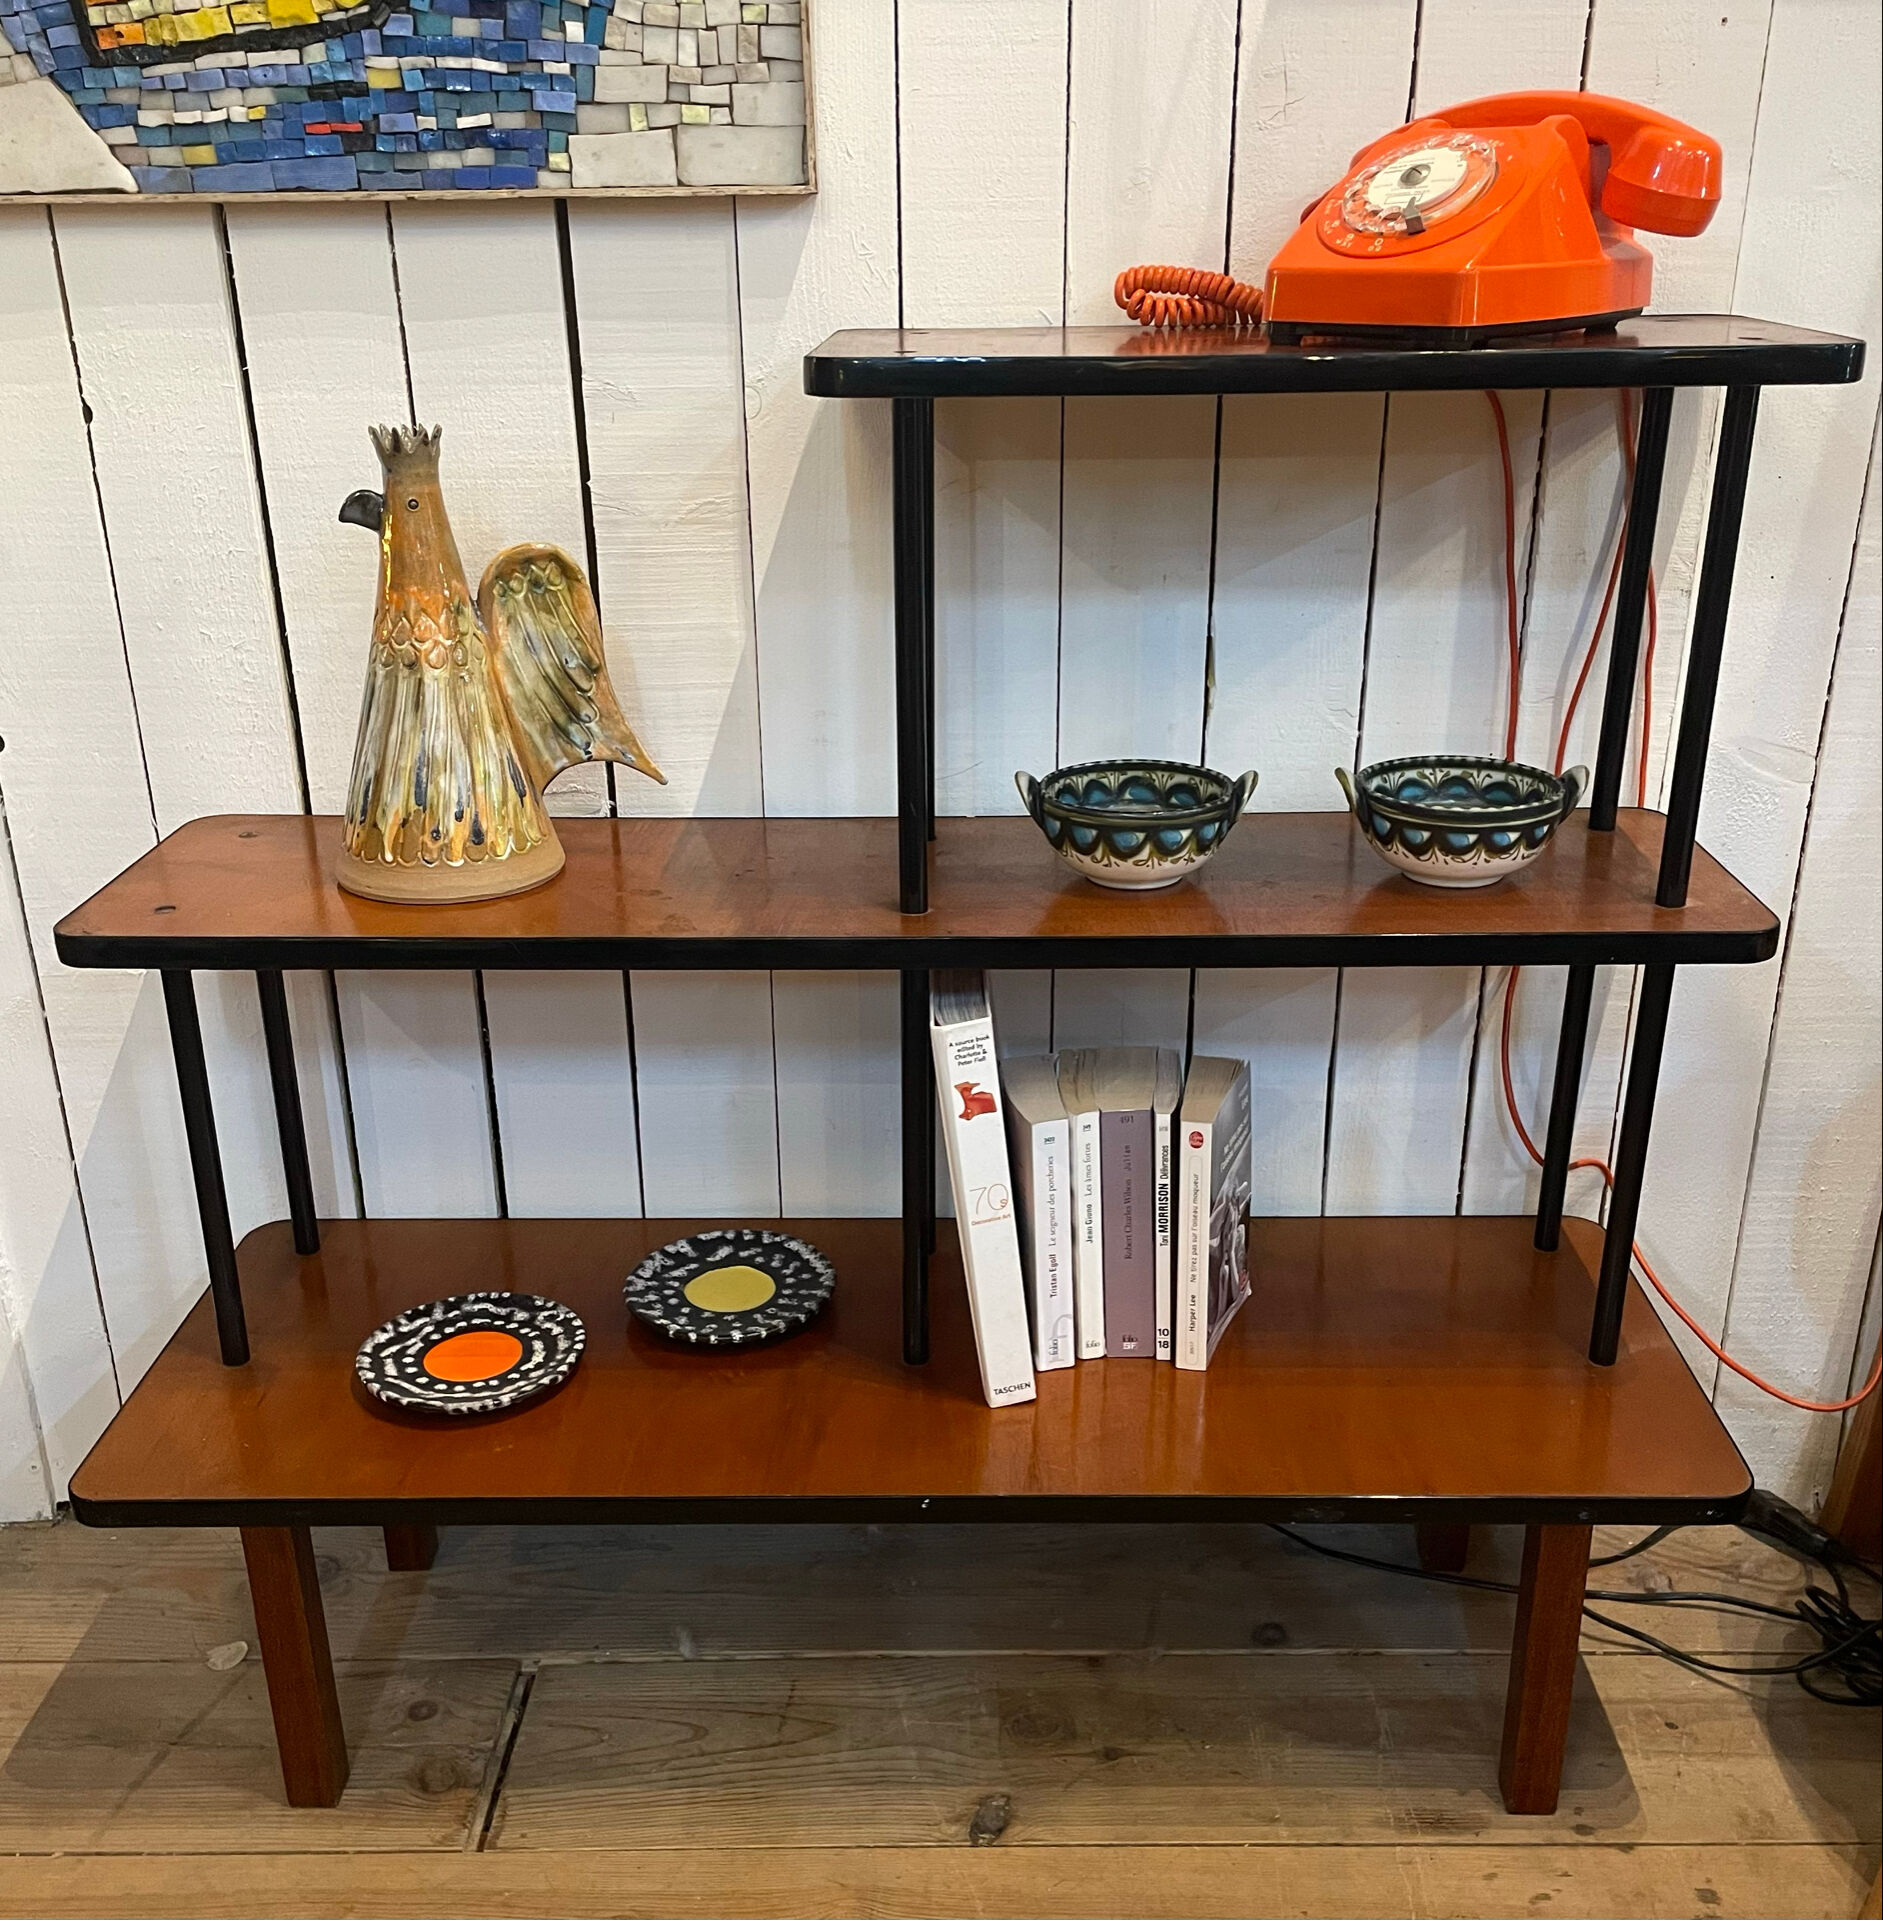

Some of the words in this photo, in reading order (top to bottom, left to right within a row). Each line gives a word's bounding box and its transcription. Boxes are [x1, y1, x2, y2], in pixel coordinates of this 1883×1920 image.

[976, 1034, 989, 1042] book
[957, 1044, 975, 1052] edited
[954, 1051, 981, 1060] Charlotte
[1083, 1143, 1092, 1163] fortes
[1046, 1156, 1056, 1192] porcheries
[1123, 1179, 1132, 1204] Wilson
[1192, 1173, 1200, 1204] moqueur
[1047, 1194, 1056, 1205] des
[1158, 1183, 1169, 1233] MORRISON
[1048, 1207, 1058, 1236] seigneur
[1123, 1205, 1132, 1233] Charles
[1048, 1237, 1056, 1247] Le
[1124, 1235, 1132, 1259] Robert
[1160, 1235, 1168, 1247] Toni
[1191, 1244, 1199, 1256] pas
[1190, 1257, 1198, 1272] tirez
[1190, 1273, 1197, 1283] Ne
[1050, 1274, 1058, 1298] Tristan
[1189, 1309, 1197, 1331] Harper
[1158, 1328, 1169, 1336] 10
[1122, 1342, 1138, 1350] SF
[993, 1381, 1031, 1395] TASCHEN
